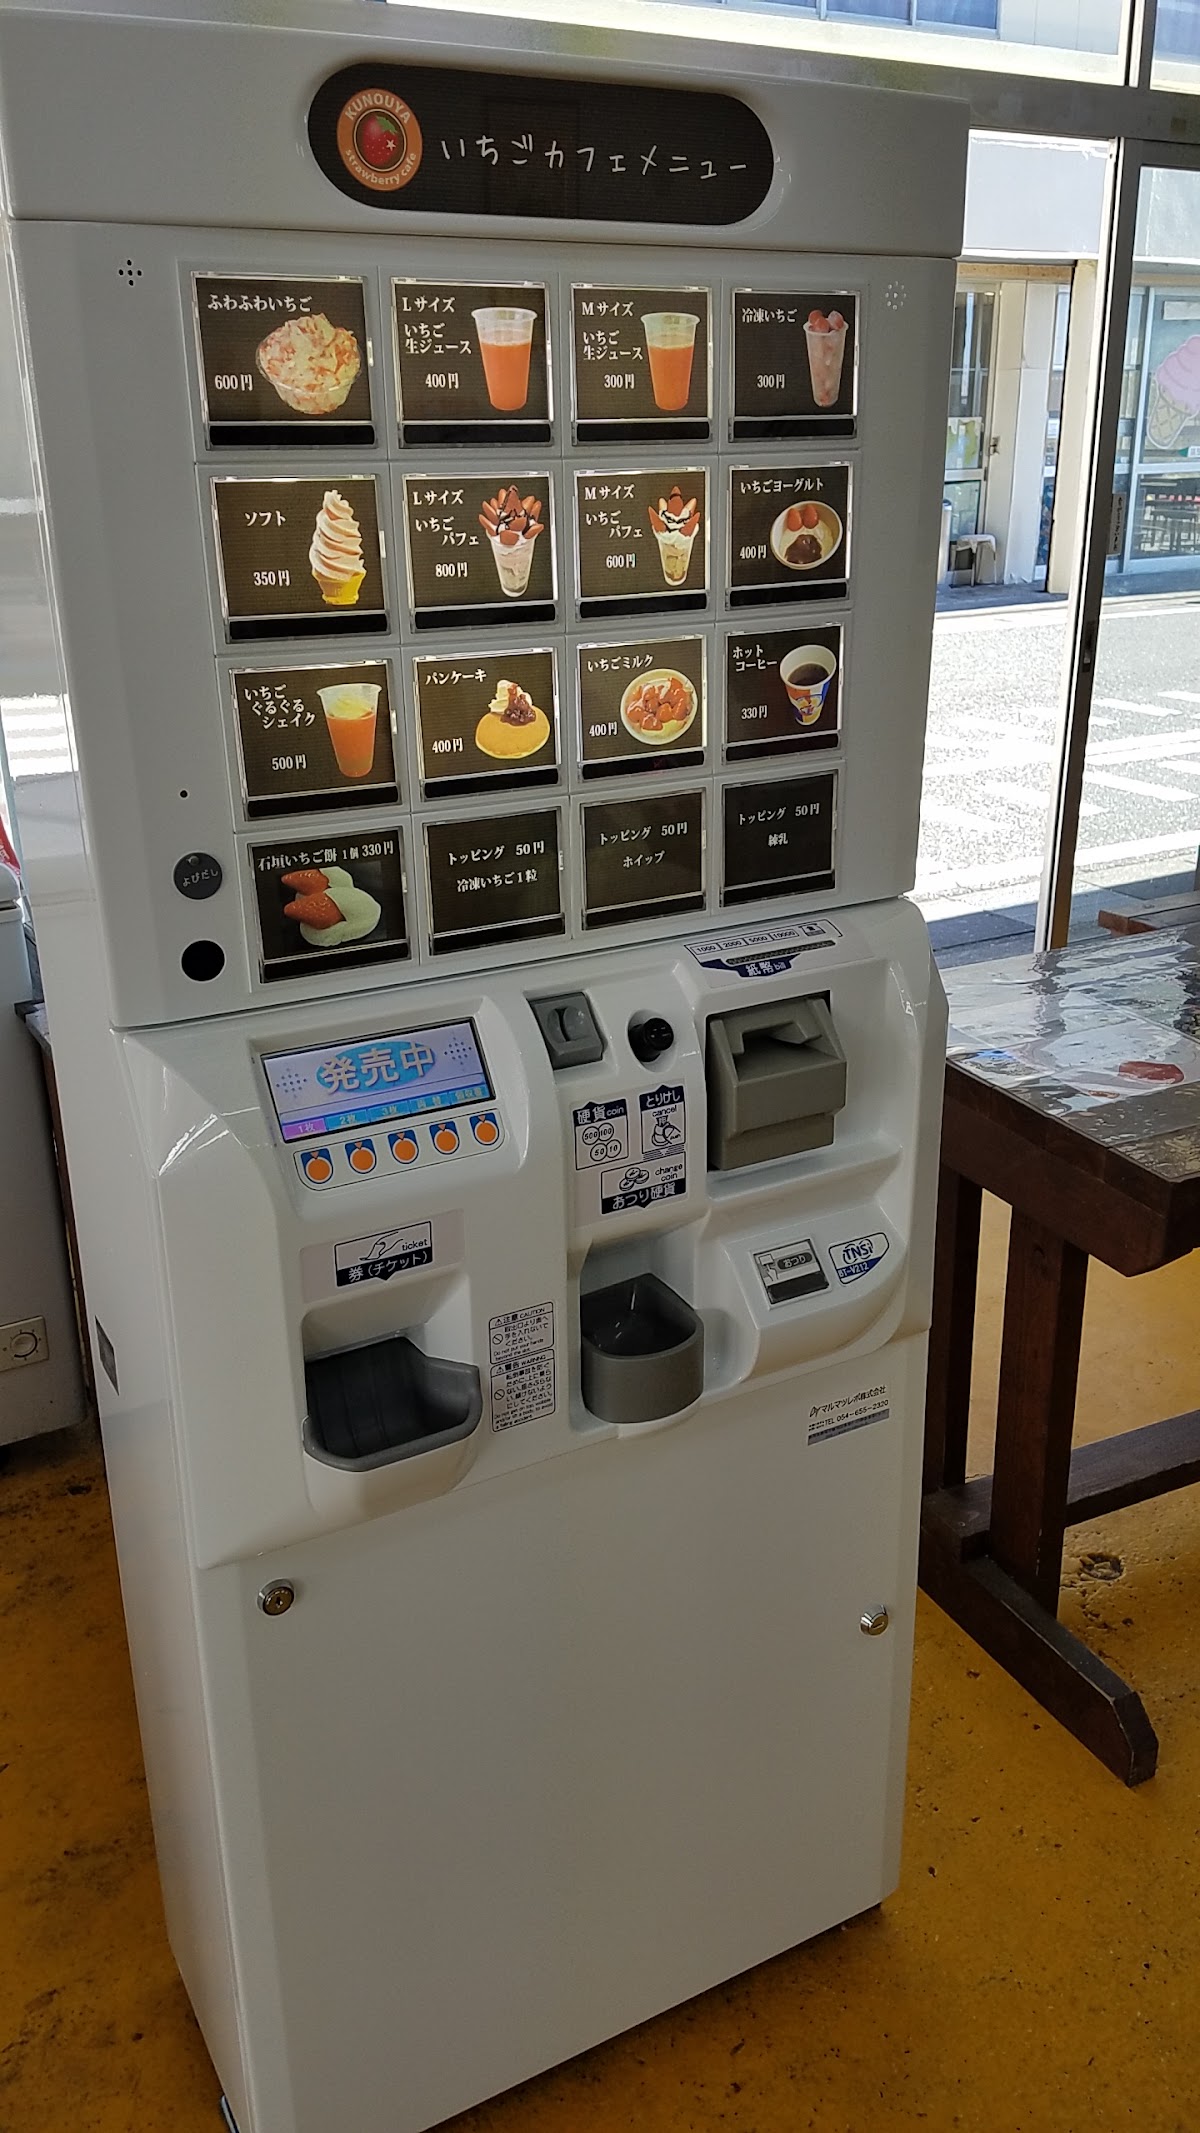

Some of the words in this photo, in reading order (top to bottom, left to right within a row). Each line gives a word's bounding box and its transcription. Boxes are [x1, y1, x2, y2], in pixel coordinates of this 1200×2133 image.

[345, 93, 411, 124] KUNOUYA
[440, 135, 746, 178] いちごカフェメニュー
[345, 149, 400, 184] strawberry
[401, 153, 416, 176] cafe
[207, 294, 313, 313] ふわふわいちご
[741, 308, 798, 323] 冷凍いちご
[404, 322, 445, 339] いちご
[583, 330, 620, 346] いちご
[405, 338, 473, 356] 生ジュース
[583, 345, 644, 361] 生ジュース
[214, 373, 253, 391] 600円
[425, 373, 460, 390] 400円
[604, 373, 635, 390] 300円
[757, 373, 785, 390] 300円
[740, 478, 824, 496] いちごヨーグルト
[244, 510, 287, 527] ソフト
[415, 516, 454, 532] いちご
[585, 511, 621, 527] いちご
[441, 531, 480, 547] パフェ
[609, 524, 643, 540] パフェ
[606, 553, 637, 569] 600円
[739, 545, 767, 560] 400円
[253, 569, 290, 587] 350円
[435, 562, 469, 578] 800円
[733, 645, 764, 660] ホット
[587, 654, 654, 673] いちごミルク
[735, 658, 778, 673] コーヒー
[425, 668, 487, 686] パンケーキ
[244, 684, 287, 701] いちご
[251, 698, 305, 715] ぐるぐる
[741, 705, 768, 720] 330円
[262, 712, 316, 730] シェイク
[589, 722, 618, 737] 400円
[431, 738, 464, 754] 400円
[271, 754, 307, 771] 500円
[739, 806, 787, 826] トッピング
[795, 802, 820, 817] 50円
[600, 826, 651, 846] トッピング
[661, 821, 688, 837] 50円
[768, 832, 788, 847] 練乳
[258, 847, 337, 871] 石垣いちご餅
[361, 840, 394, 857] 330円
[448, 845, 505, 866] トッピング
[516, 840, 545, 856] 50円
[623, 850, 665, 869] ホイップ
[182, 869, 218, 887] よびだし
[457, 868, 538, 893] 冷凍いちご1粒
[696, 945, 716, 953] 1000
[723, 940, 742, 948] 2000
[319, 1041, 435, 1095] 発売中
[646, 1089, 680, 1108] とりけし
[577, 1105, 606, 1124] 硬貨
[607, 1105, 624, 1116] coin
[652, 1105, 677, 1118] cancel
[584, 1131, 598, 1140] 500
[600, 1128, 612, 1137] 100
[594, 1148, 605, 1156] 50
[609, 1144, 618, 1152] 10
[654, 1163, 683, 1176] change
[661, 1172, 678, 1182] coin
[612, 1182, 675, 1210] おつり硬貨
[402, 1238, 427, 1251] ticket
[783, 1255, 806, 1268] おつり
[838, 1262, 869, 1277] BT-V212
